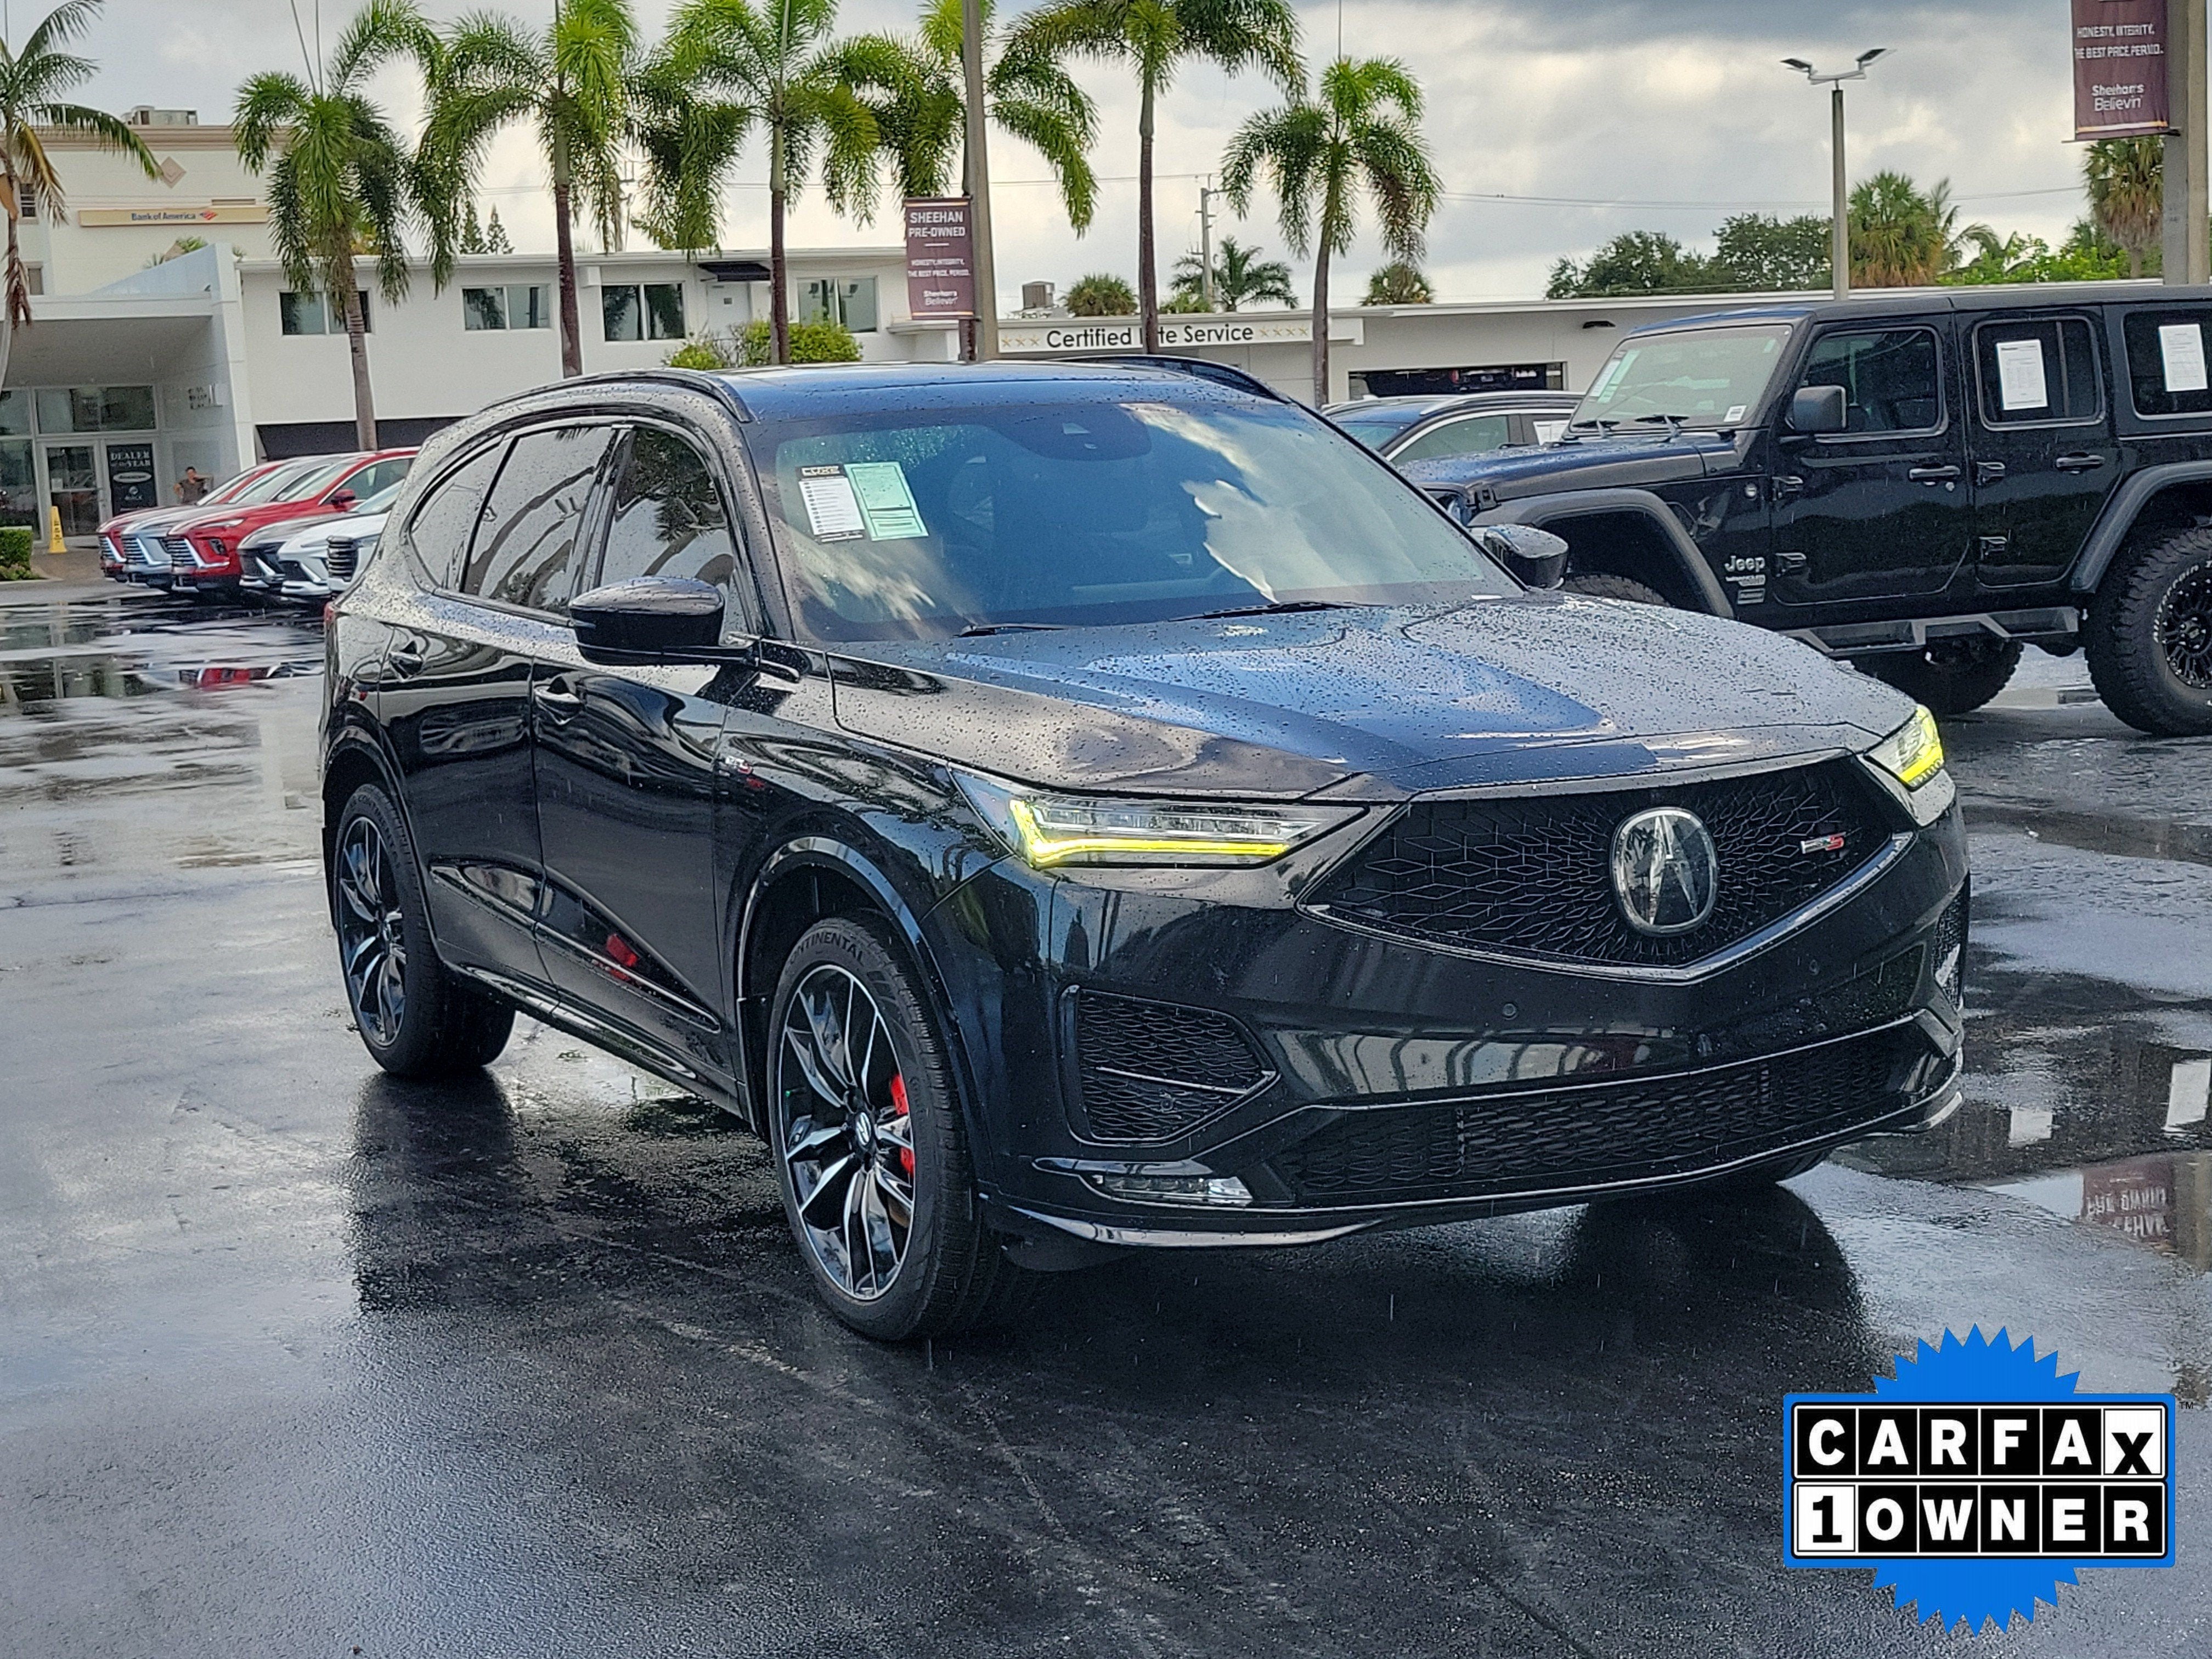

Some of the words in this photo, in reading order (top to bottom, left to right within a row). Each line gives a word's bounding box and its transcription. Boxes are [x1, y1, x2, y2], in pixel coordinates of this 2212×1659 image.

[2086, 46, 2106, 59] BEST
[153, 212, 161, 220] of
[163, 212, 196, 220] America
[910, 211, 964, 224] SHEEHAN
[909, 227, 966, 238] PRE-OWNED
[1047, 327, 1132, 348] Certified
[1183, 323, 1254, 343] Service
[1724, 555, 1766, 572] Jeep
